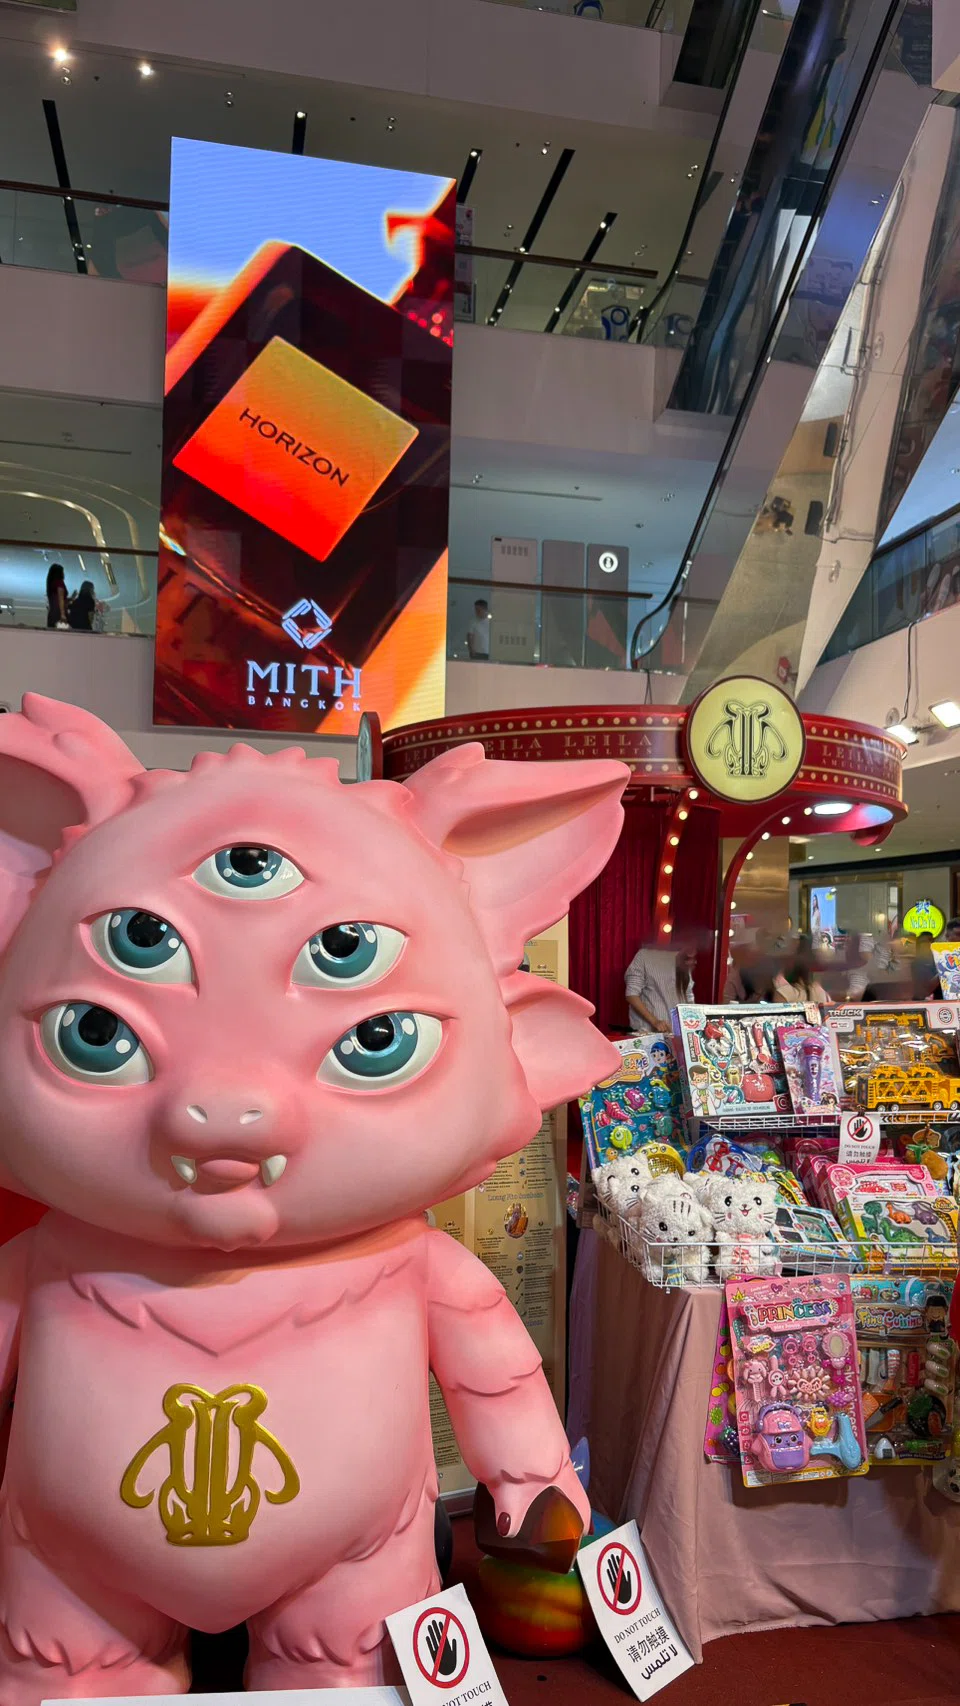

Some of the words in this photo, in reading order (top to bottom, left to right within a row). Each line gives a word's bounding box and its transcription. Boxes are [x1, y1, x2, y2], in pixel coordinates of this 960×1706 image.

[239, 408, 349, 487] HORIZON
[246, 660, 362, 698] MITH
[247, 695, 360, 711] BANGKOK
[484, 737, 542, 751] EILA
[564, 734, 653, 748] LEILA
[563, 748, 653, 756] AMULETS
[828, 1009, 863, 1017] TRUCK
[624, 1056, 649, 1070] GAME
[758, 1301, 832, 1322] PRINCESS
[614, 1630, 625, 1643] DO
[624, 1621, 639, 1637] NOT
[639, 1607, 661, 1628] TOUCH
[626, 1626, 670, 1663] 请勿触摸
[460, 1680, 492, 1703] TOUCH
